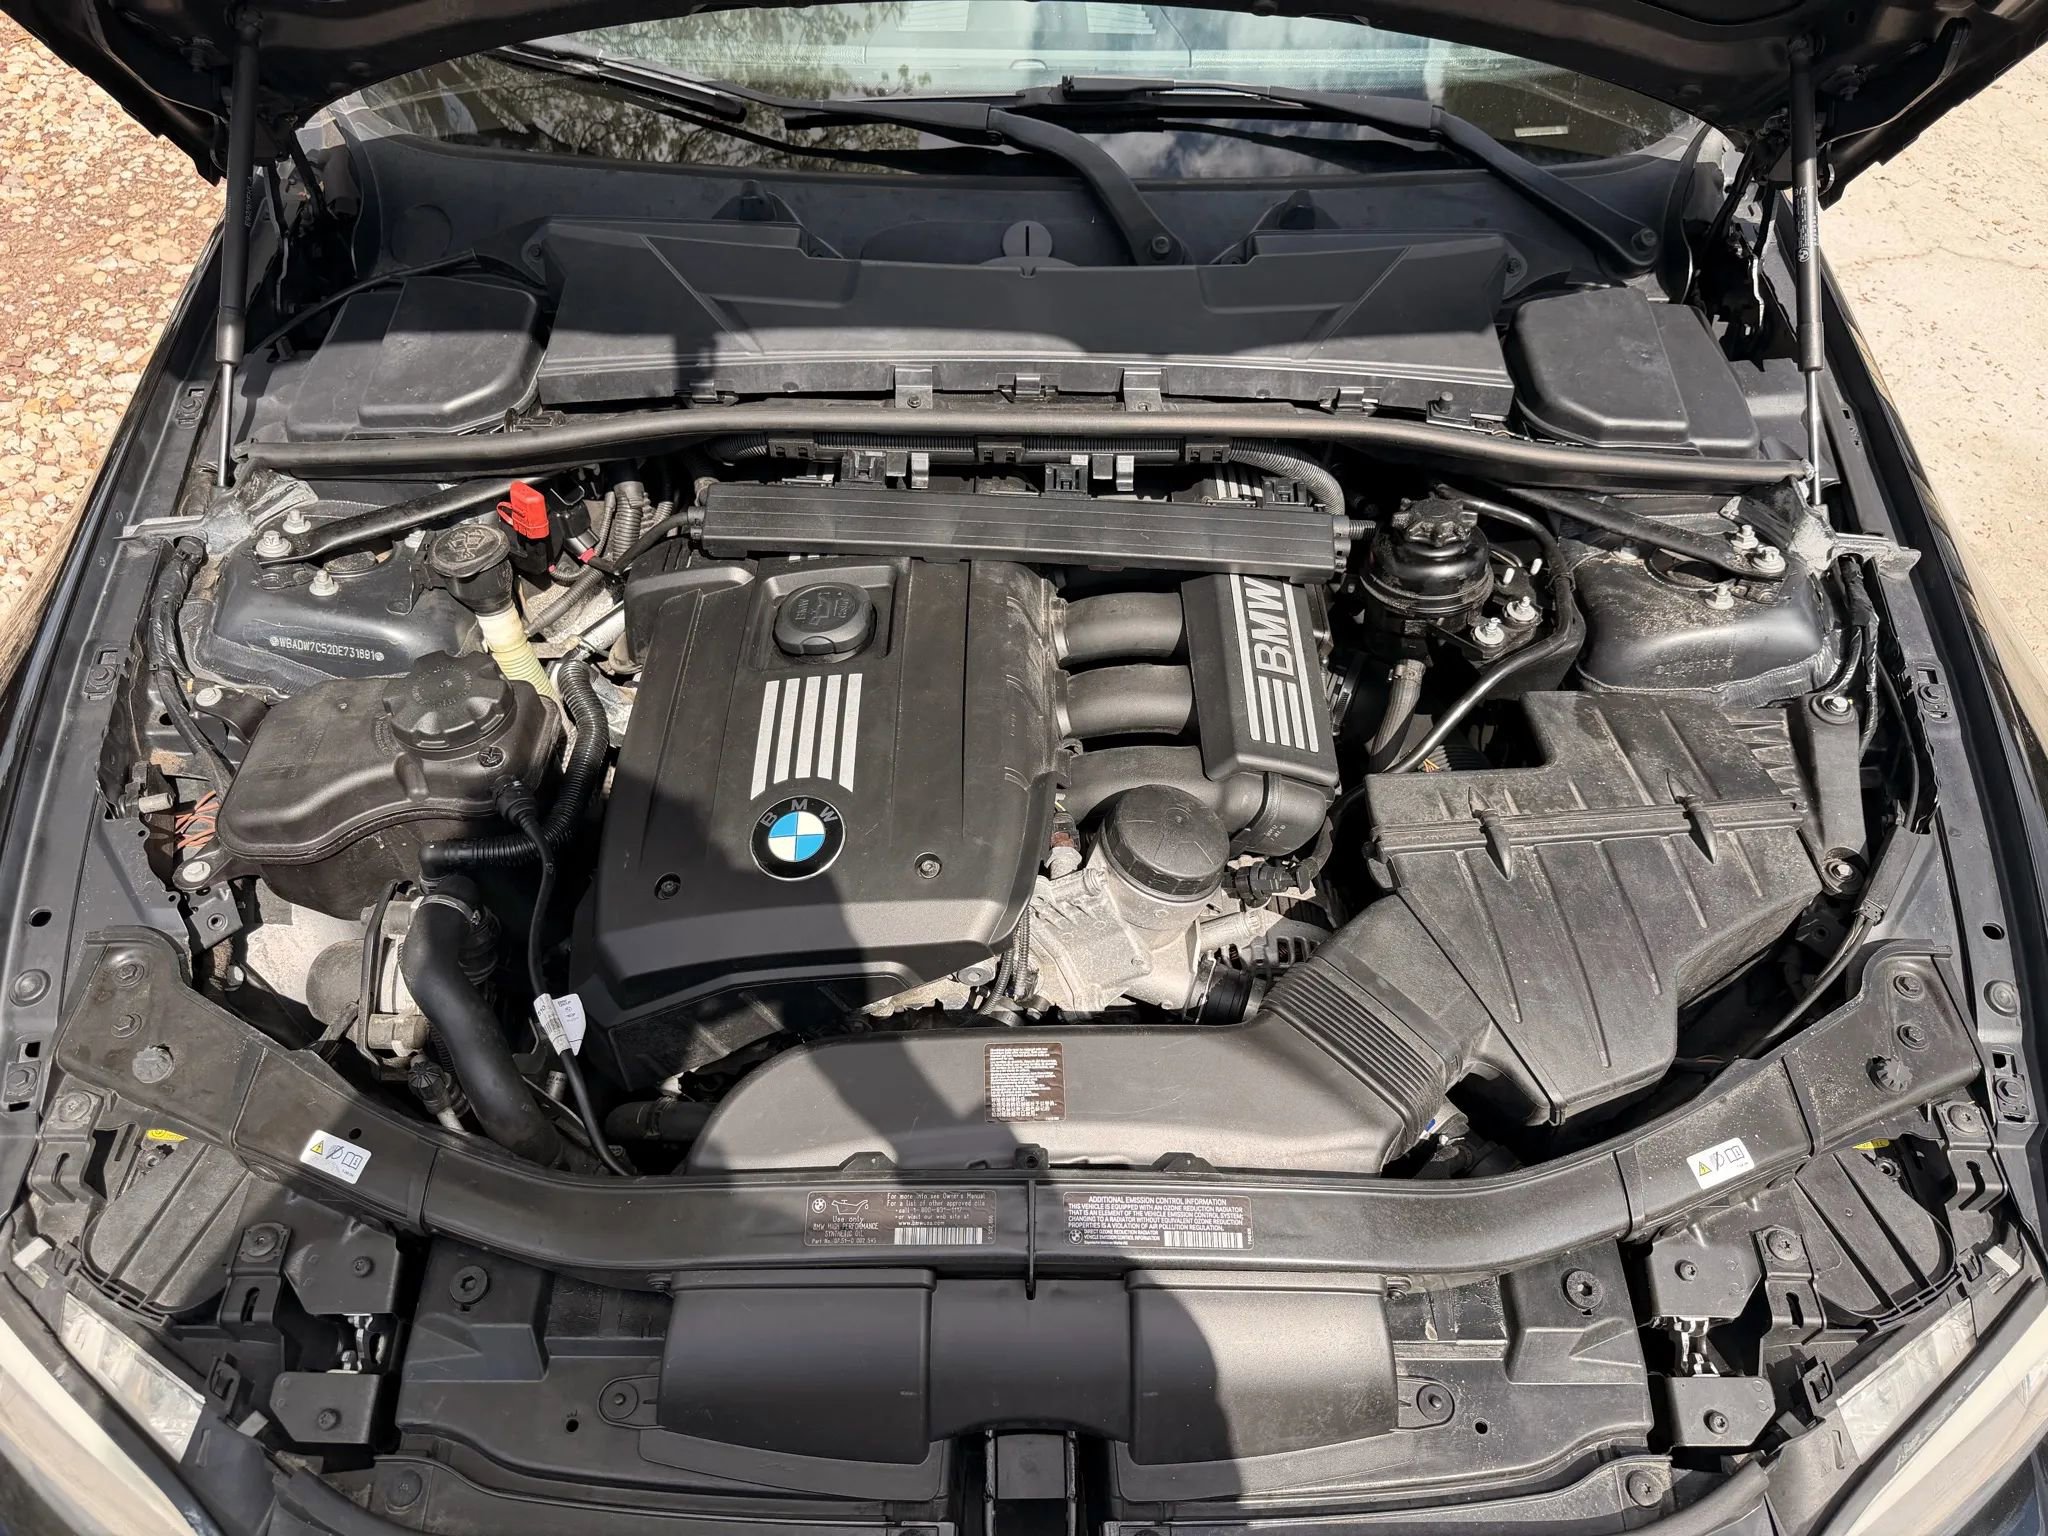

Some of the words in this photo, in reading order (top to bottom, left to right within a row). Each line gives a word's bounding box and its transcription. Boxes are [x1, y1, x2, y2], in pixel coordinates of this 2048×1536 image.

[1243, 575, 1295, 676] BMW
[280, 637, 375, 661] WBADW7C52DE731891
[760, 798, 839, 828] BMW
[887, 1192, 896, 1200] For
[1126, 1196, 1154, 1204] EMISSION
[848, 1216, 864, 1224] only
